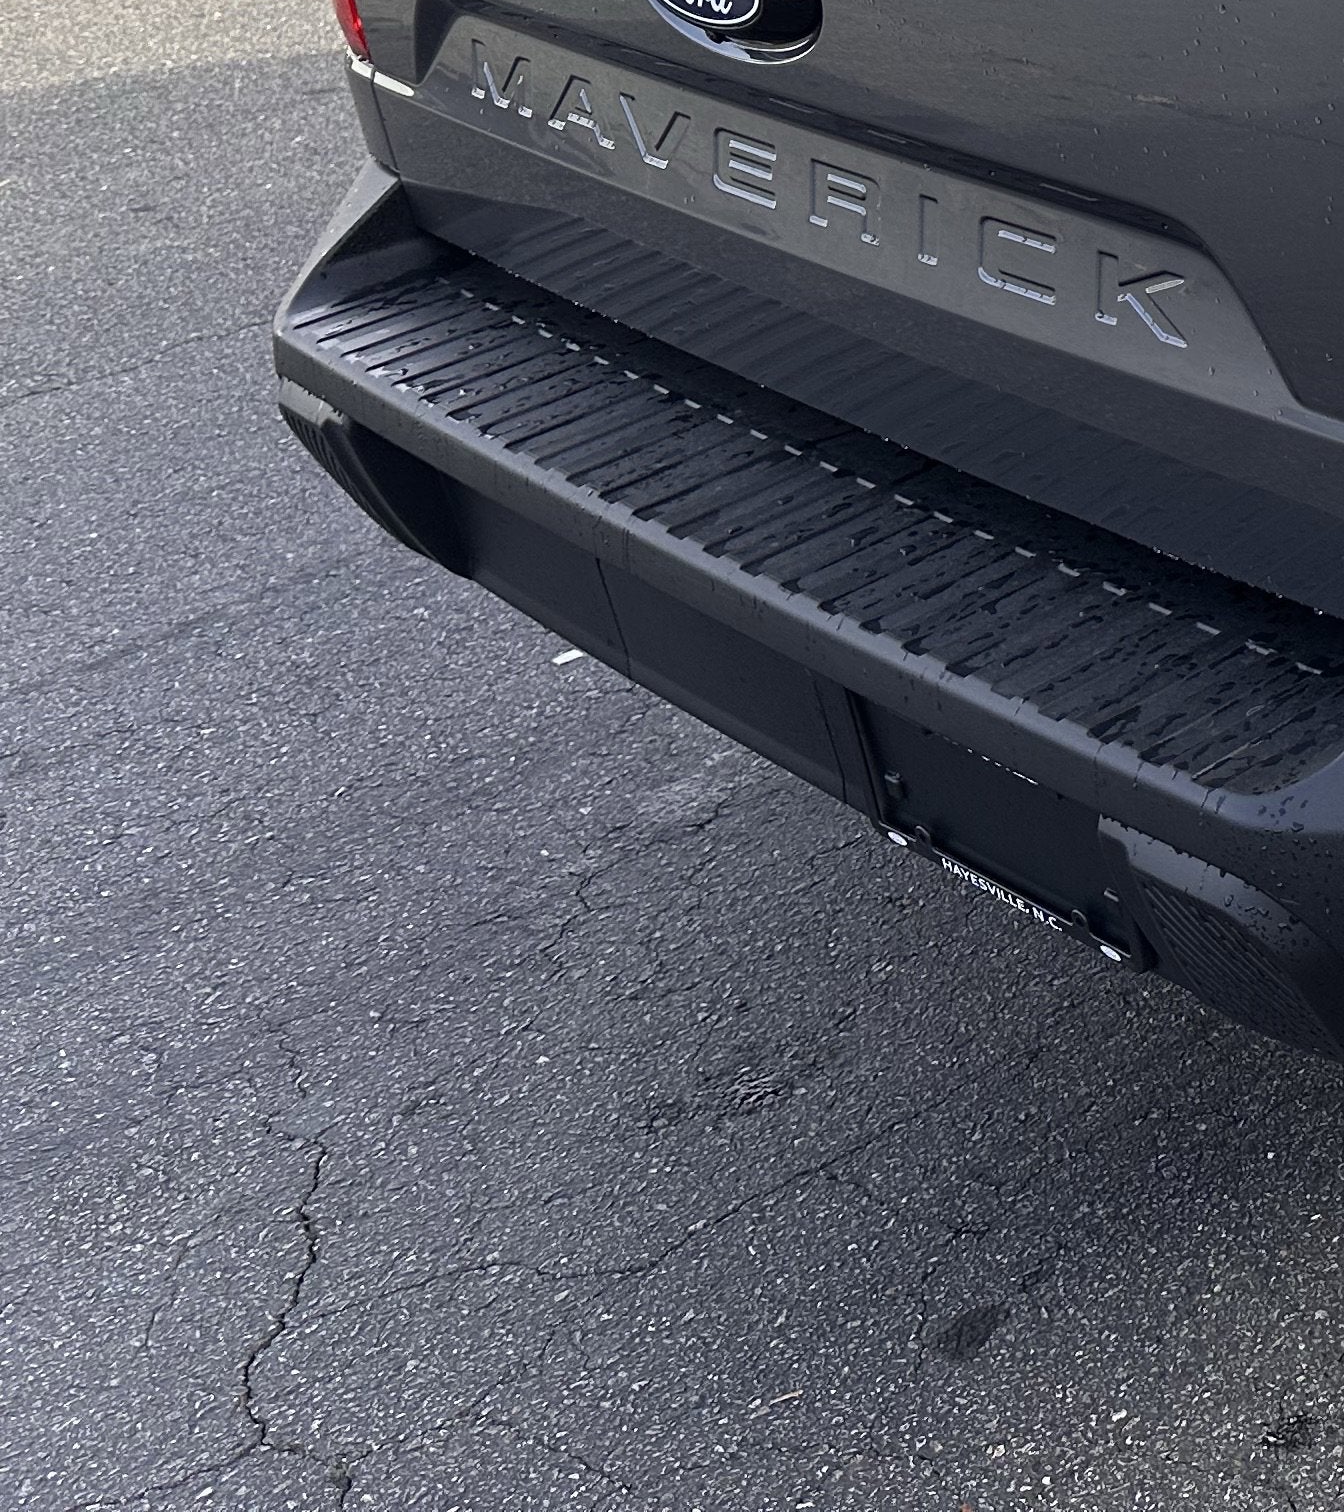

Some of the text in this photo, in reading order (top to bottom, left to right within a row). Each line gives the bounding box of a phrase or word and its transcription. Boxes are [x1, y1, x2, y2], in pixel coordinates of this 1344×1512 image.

[469, 37, 1189, 349] MAVERICK
[941, 857, 1063, 932] HAYESVILLE, N.C.
